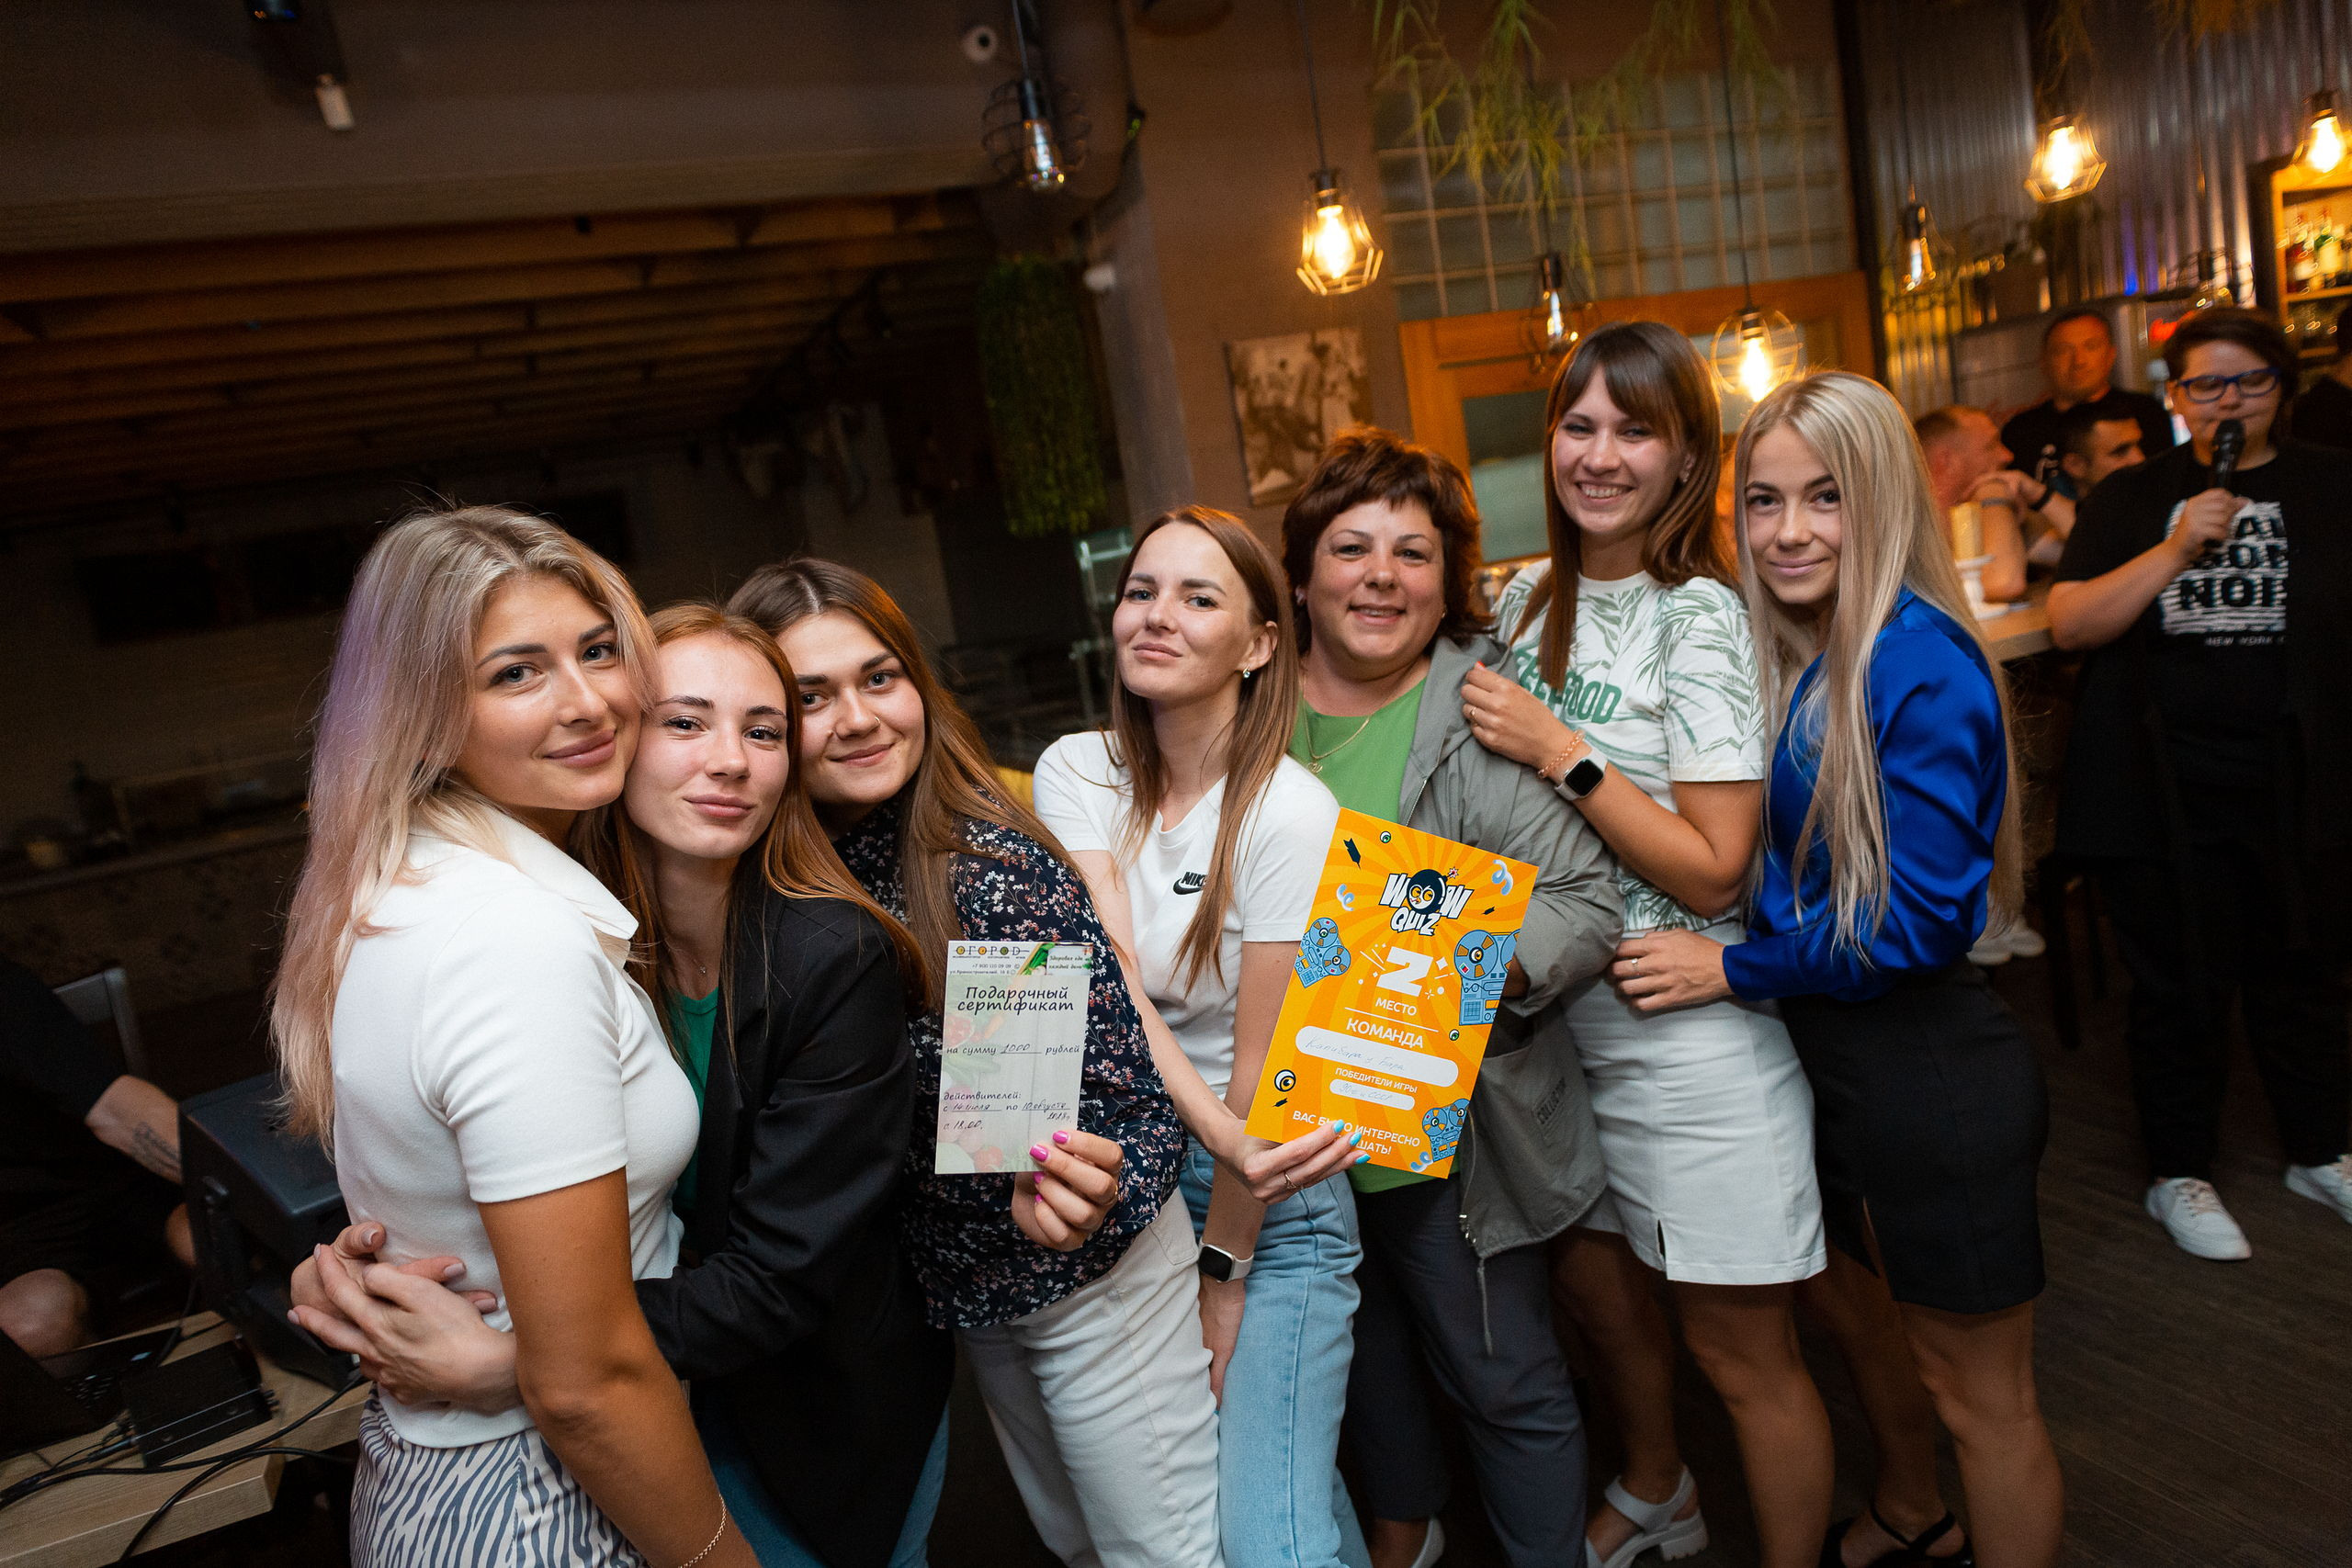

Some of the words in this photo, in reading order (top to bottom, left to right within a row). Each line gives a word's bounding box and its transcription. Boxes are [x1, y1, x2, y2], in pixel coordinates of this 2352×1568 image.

[1181, 871, 1207, 887] NIK
[1390, 906, 1442, 937] QUIZ
[1376, 946, 1434, 997] 2
[966, 986, 1069, 1002] Подарочный
[957, 999, 1073, 1015] сертификат
[1375, 998, 1417, 1016] МЕСТО
[1346, 1018, 1424, 1048] КОМАНДА
[962, 1047, 997, 1056] сумму
[1001, 1043, 1030, 1054] 1000
[1046, 1043, 1080, 1055] рублей
[1335, 1067, 1393, 1088] ПОБЕДИТЕЛИ
[1394, 1083, 1418, 1093] ИГРЫ
[1293, 1111, 1317, 1124] ВАС
[1317, 1116, 1353, 1132] БО
[1355, 1124, 1420, 1147] ИНТЕРЕСНО
